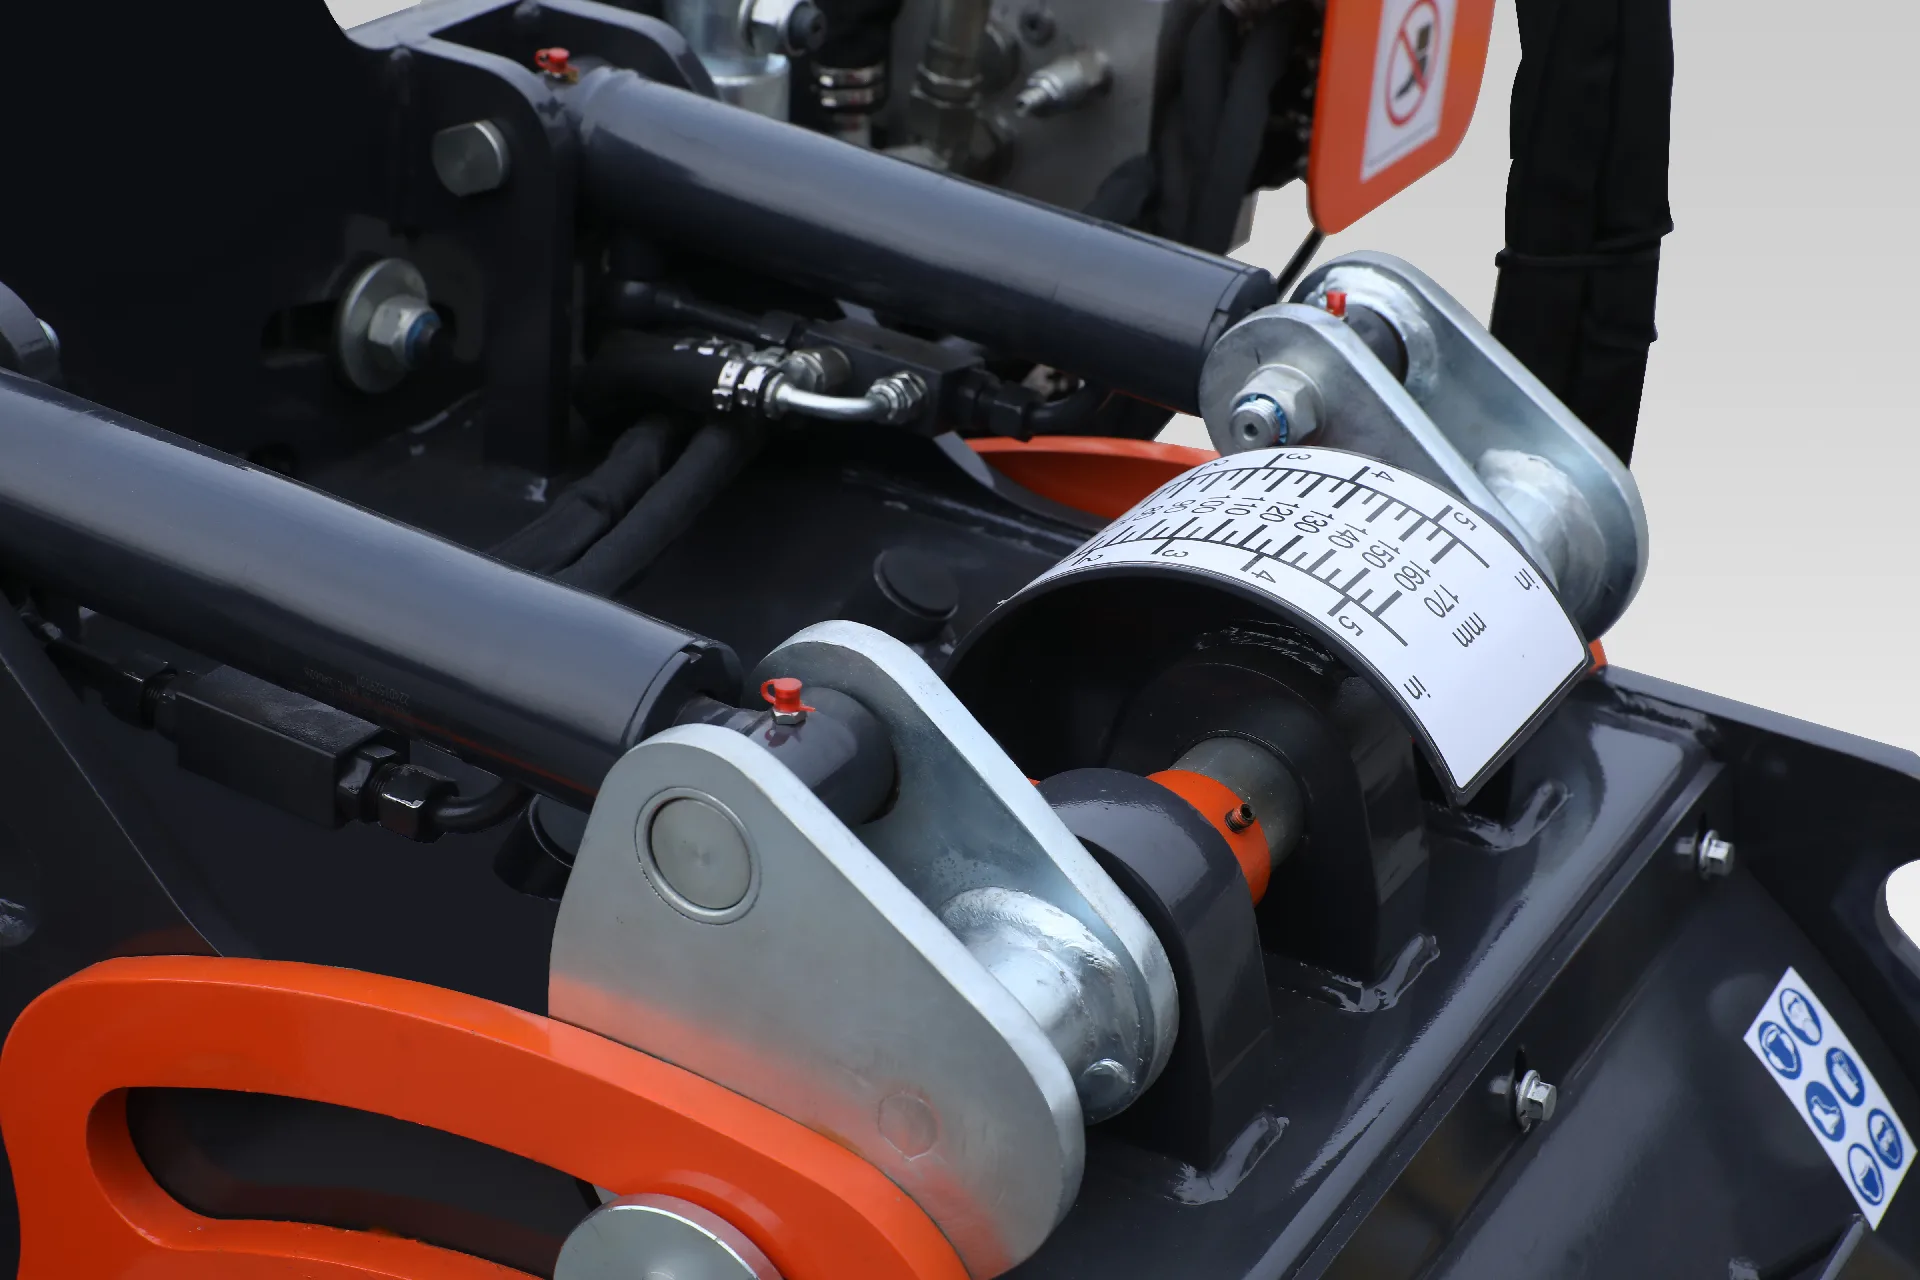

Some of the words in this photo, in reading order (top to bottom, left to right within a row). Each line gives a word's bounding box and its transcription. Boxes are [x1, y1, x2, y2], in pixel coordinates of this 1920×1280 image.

[1371, 470, 1395, 482] 4
[1192, 495, 1231, 514] 100
[1225, 497, 1266, 515] 110
[1260, 501, 1300, 522] 120
[1294, 510, 1335, 533] 130
[1453, 511, 1477, 532] 5
[1328, 523, 1368, 548] 140
[1162, 549, 1189, 558] 3
[1362, 540, 1400, 568] 150
[1251, 569, 1277, 584] 4
[1394, 560, 1432, 592] 160
[1514, 568, 1540, 591] in
[1424, 584, 1460, 618] 170
[1338, 615, 1364, 637] 5
[1452, 612, 1487, 647] mm
[1403, 675, 1431, 700] in
